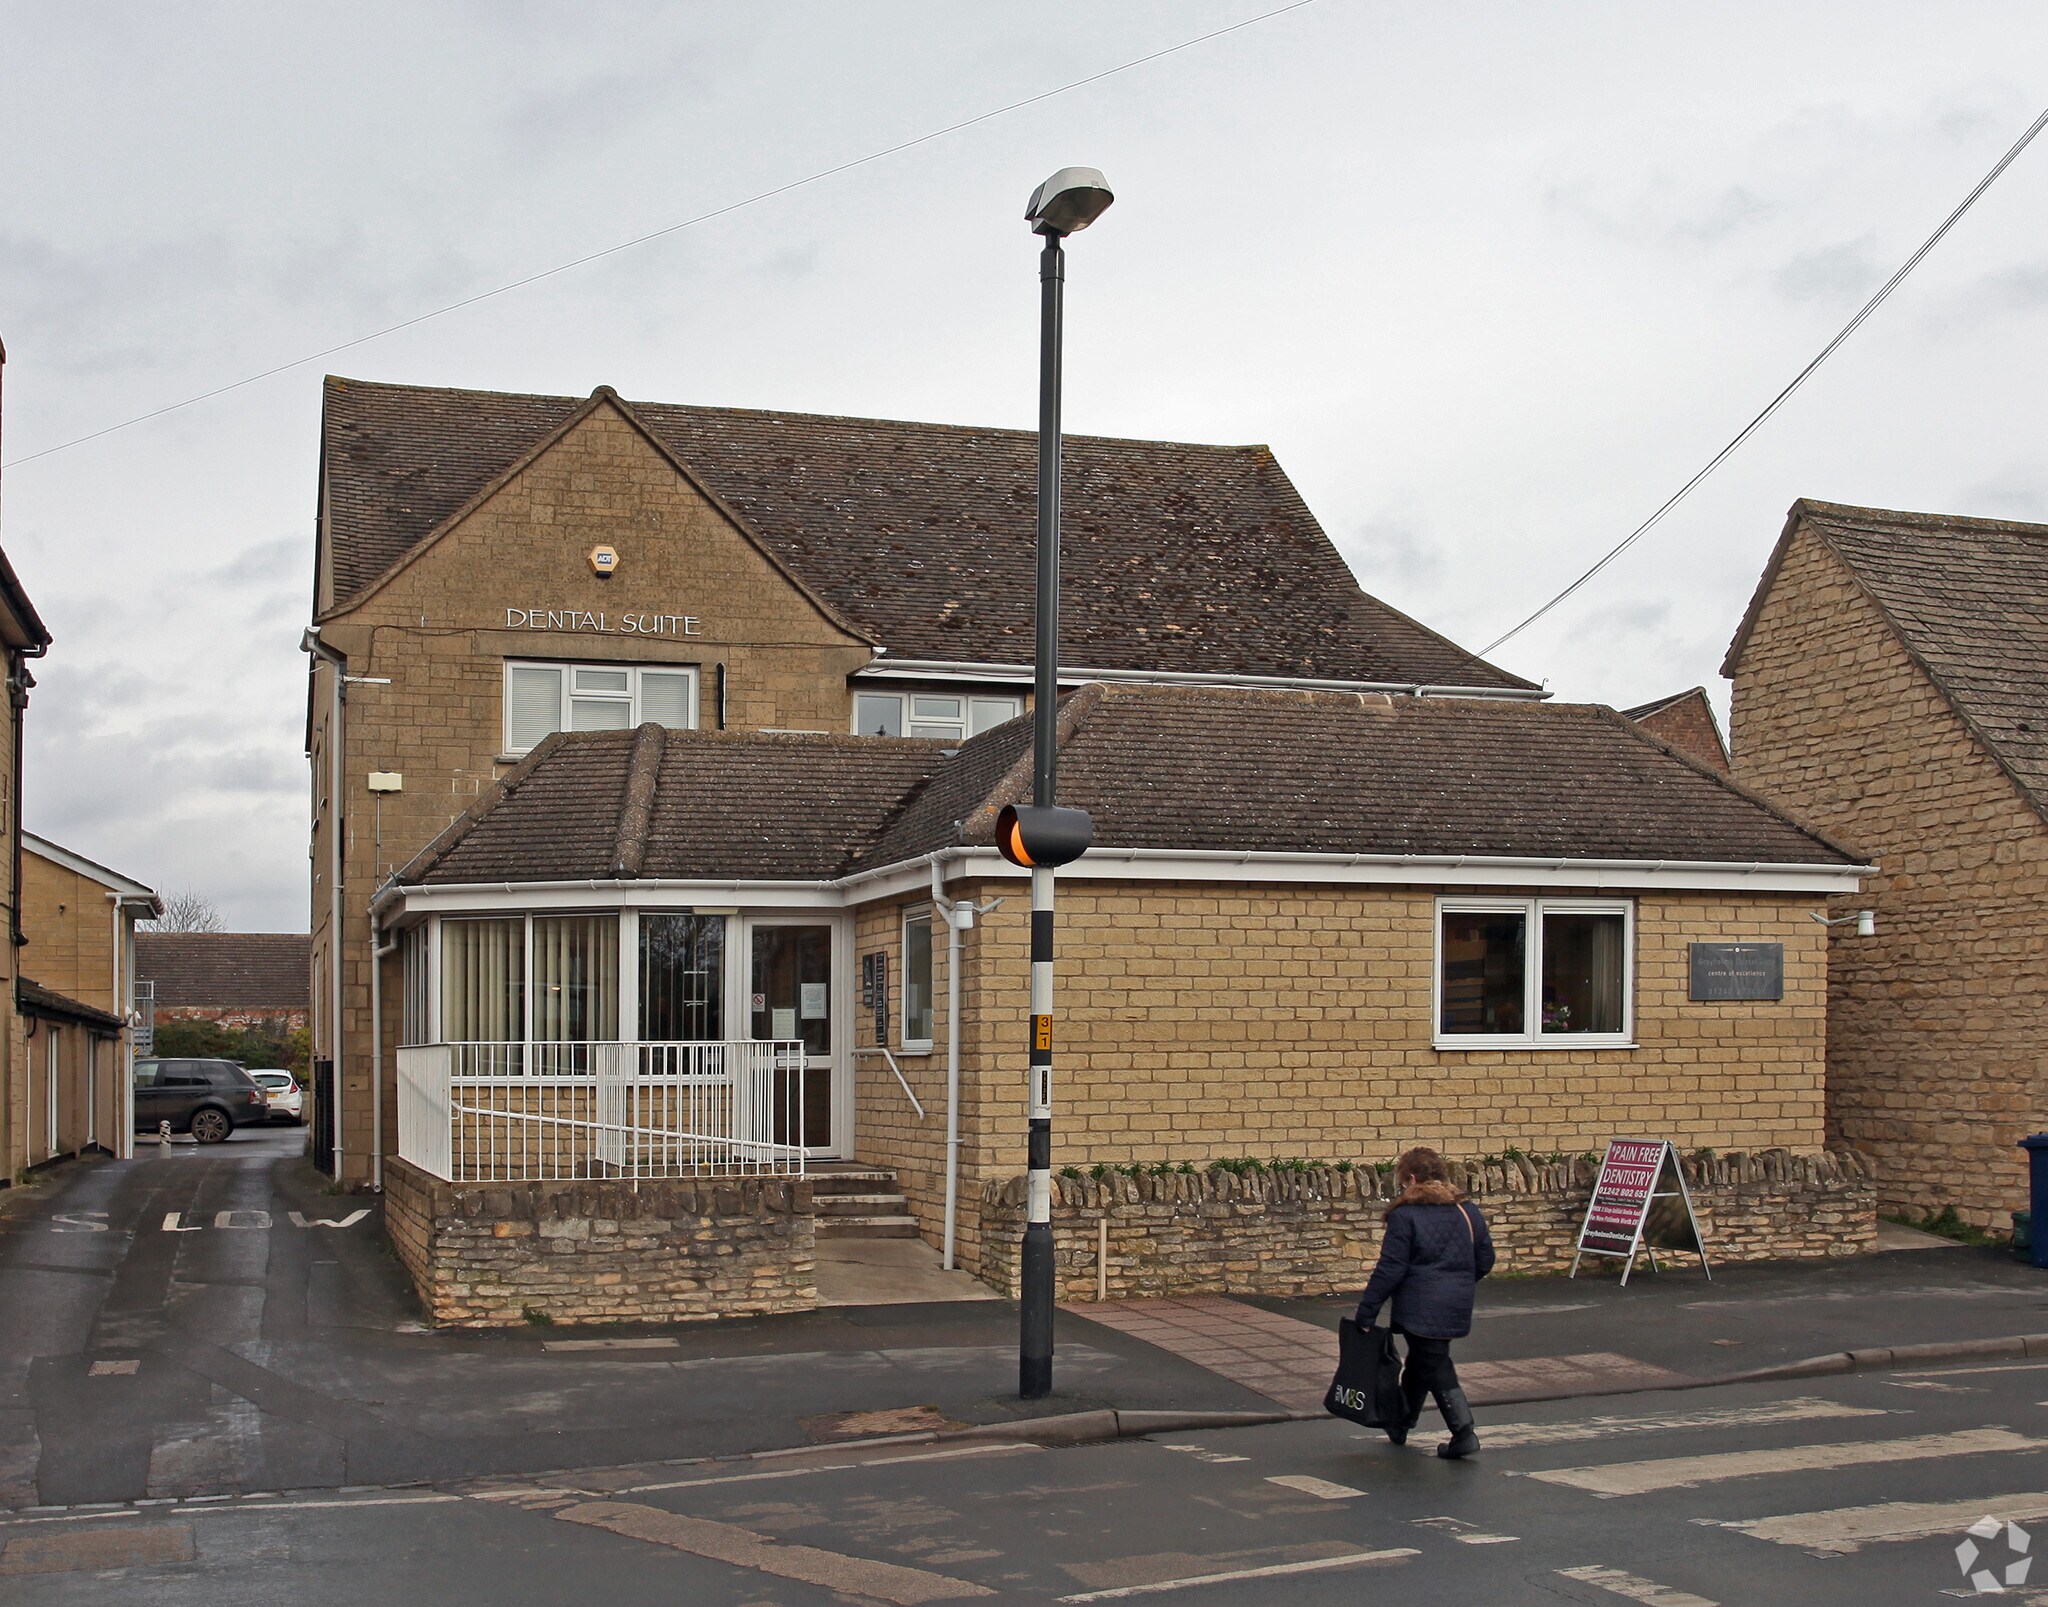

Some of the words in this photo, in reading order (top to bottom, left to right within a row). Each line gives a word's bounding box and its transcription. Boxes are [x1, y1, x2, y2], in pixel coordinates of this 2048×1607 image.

[596, 553, 613, 564] ADT
[506, 608, 615, 632] DENTAL
[620, 613, 702, 636] SUITE
[1041, 1017, 1049, 1027] 3
[1041, 1037, 1047, 1047] 1
[1638, 1147, 1660, 1162] FREE
[1602, 1168, 1653, 1186] DENTISTRY
[1598, 1186, 1620, 1196] 01242
[50, 1209, 373, 1233] SLOW
[1339, 1386, 1366, 1410] M&S
